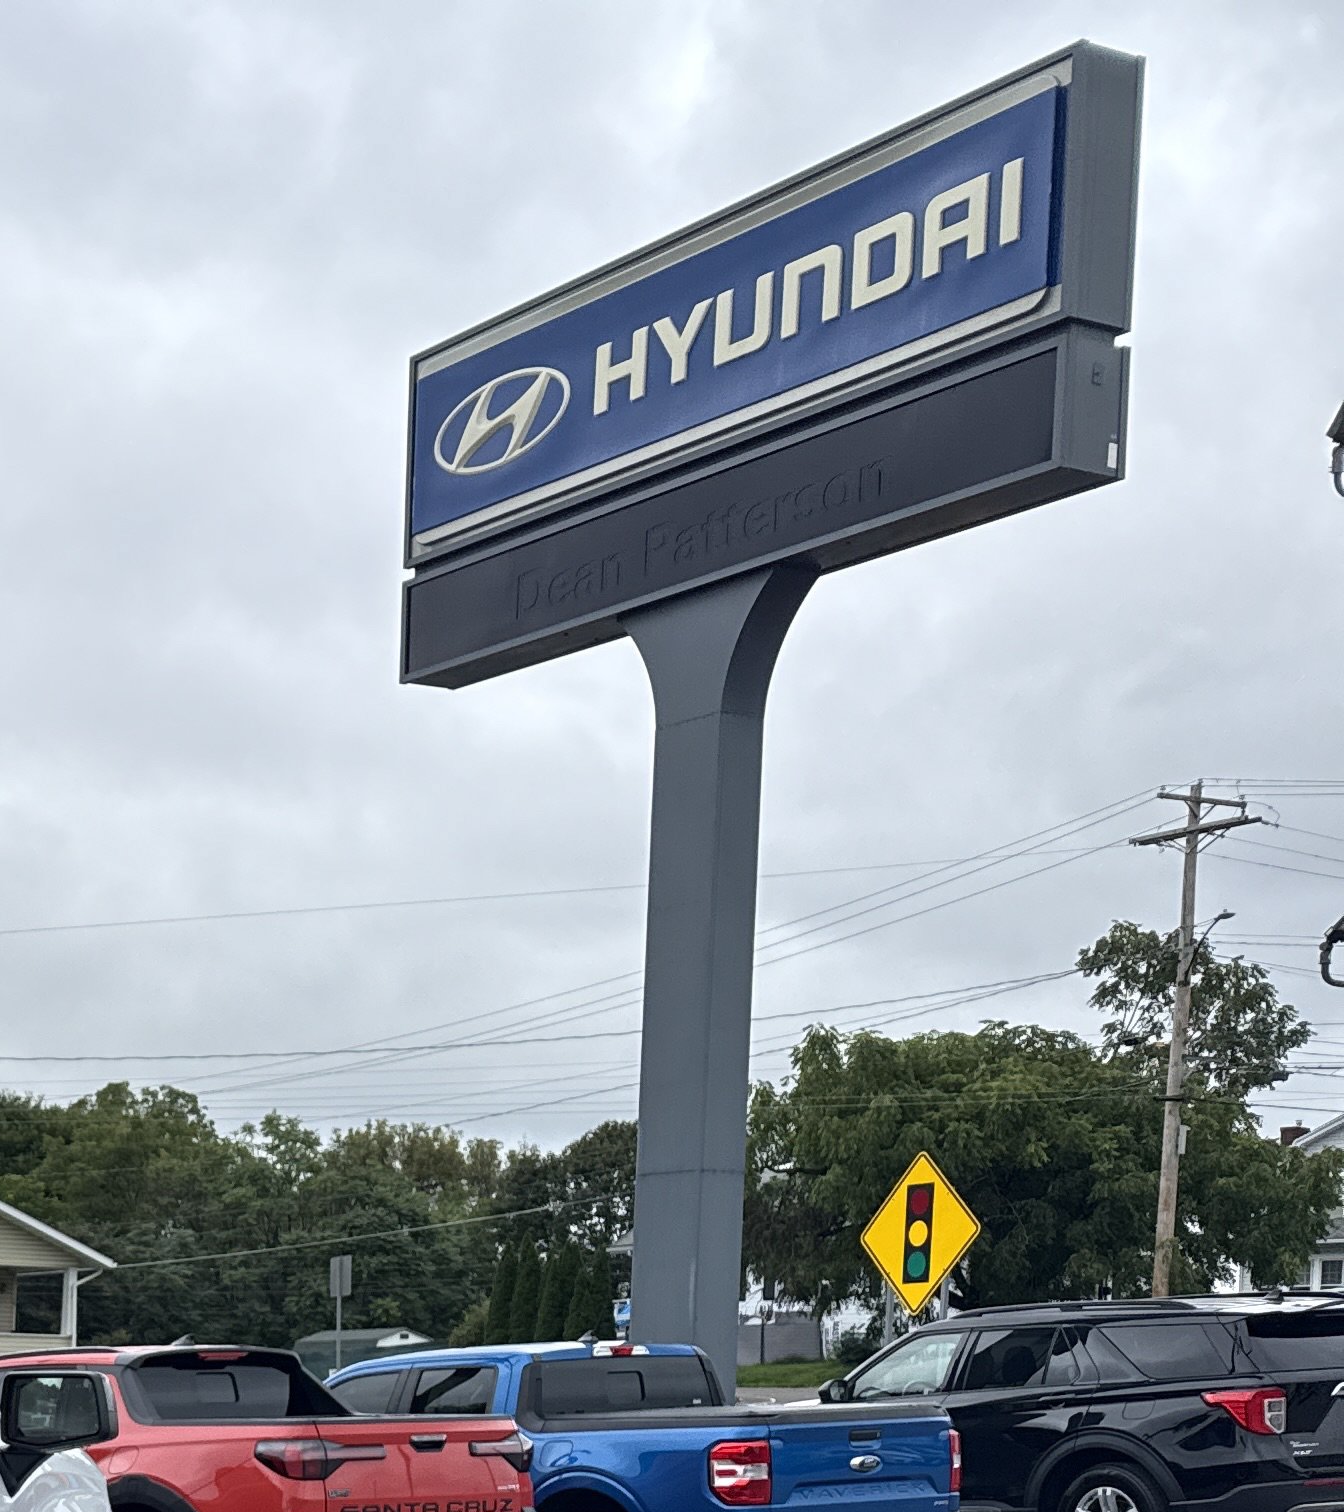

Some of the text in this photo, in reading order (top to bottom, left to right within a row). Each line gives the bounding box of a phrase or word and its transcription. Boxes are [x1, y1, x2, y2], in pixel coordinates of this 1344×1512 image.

[593, 158, 1025, 416] HYUNDAI
[515, 460, 888, 622] Dean Patterson
[799, 1481, 925, 1499] MAVERICK
